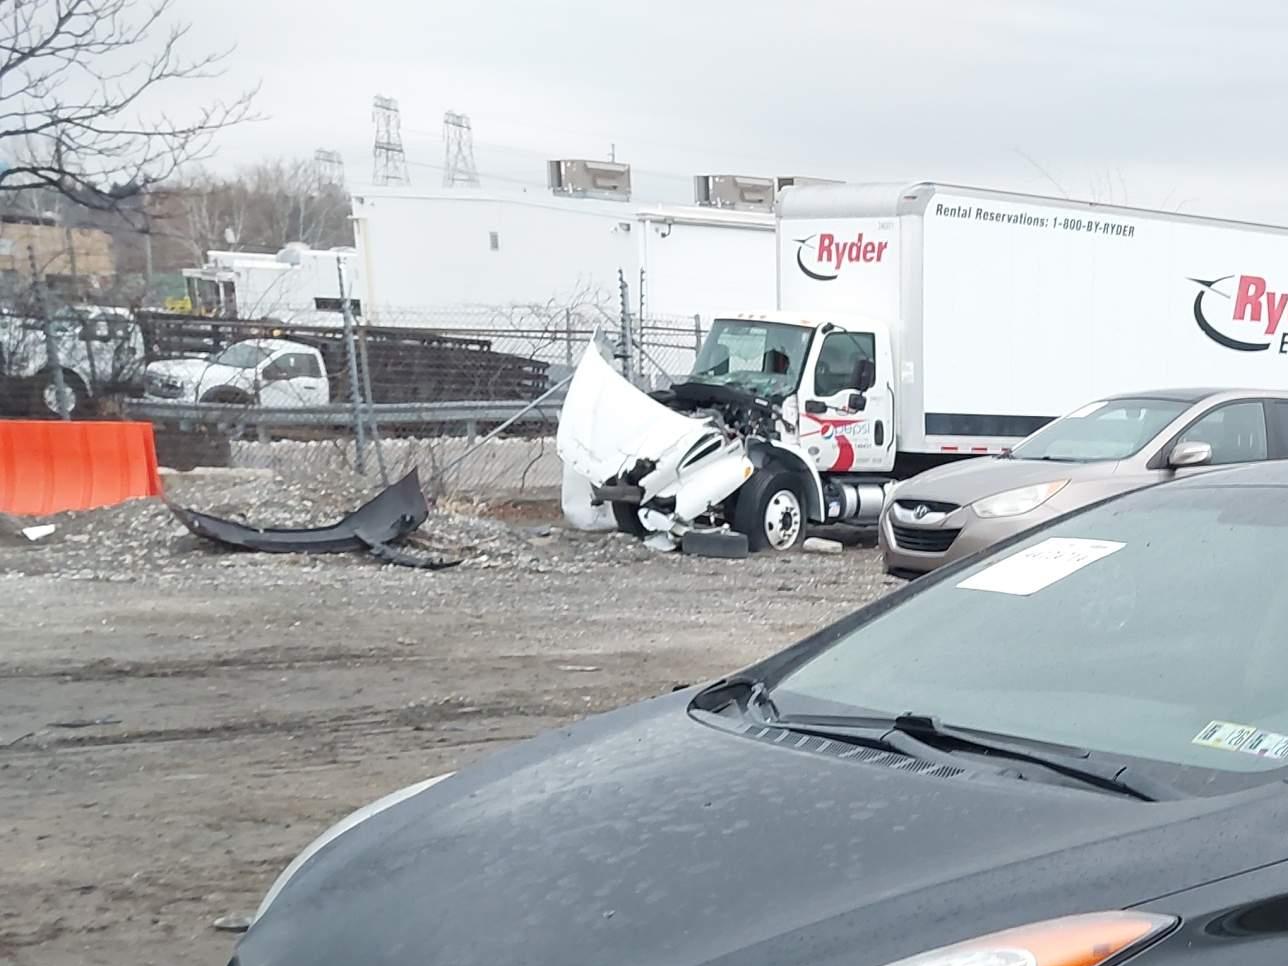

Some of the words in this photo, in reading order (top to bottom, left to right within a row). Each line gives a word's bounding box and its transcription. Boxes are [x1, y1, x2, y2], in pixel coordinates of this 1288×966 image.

[935, 203, 972, 219] Rental
[975, 207, 1049, 228] Reservations:
[1052, 216, 1135, 238] 1-800-BY-RYDER
[817, 232, 888, 271] Ryder
